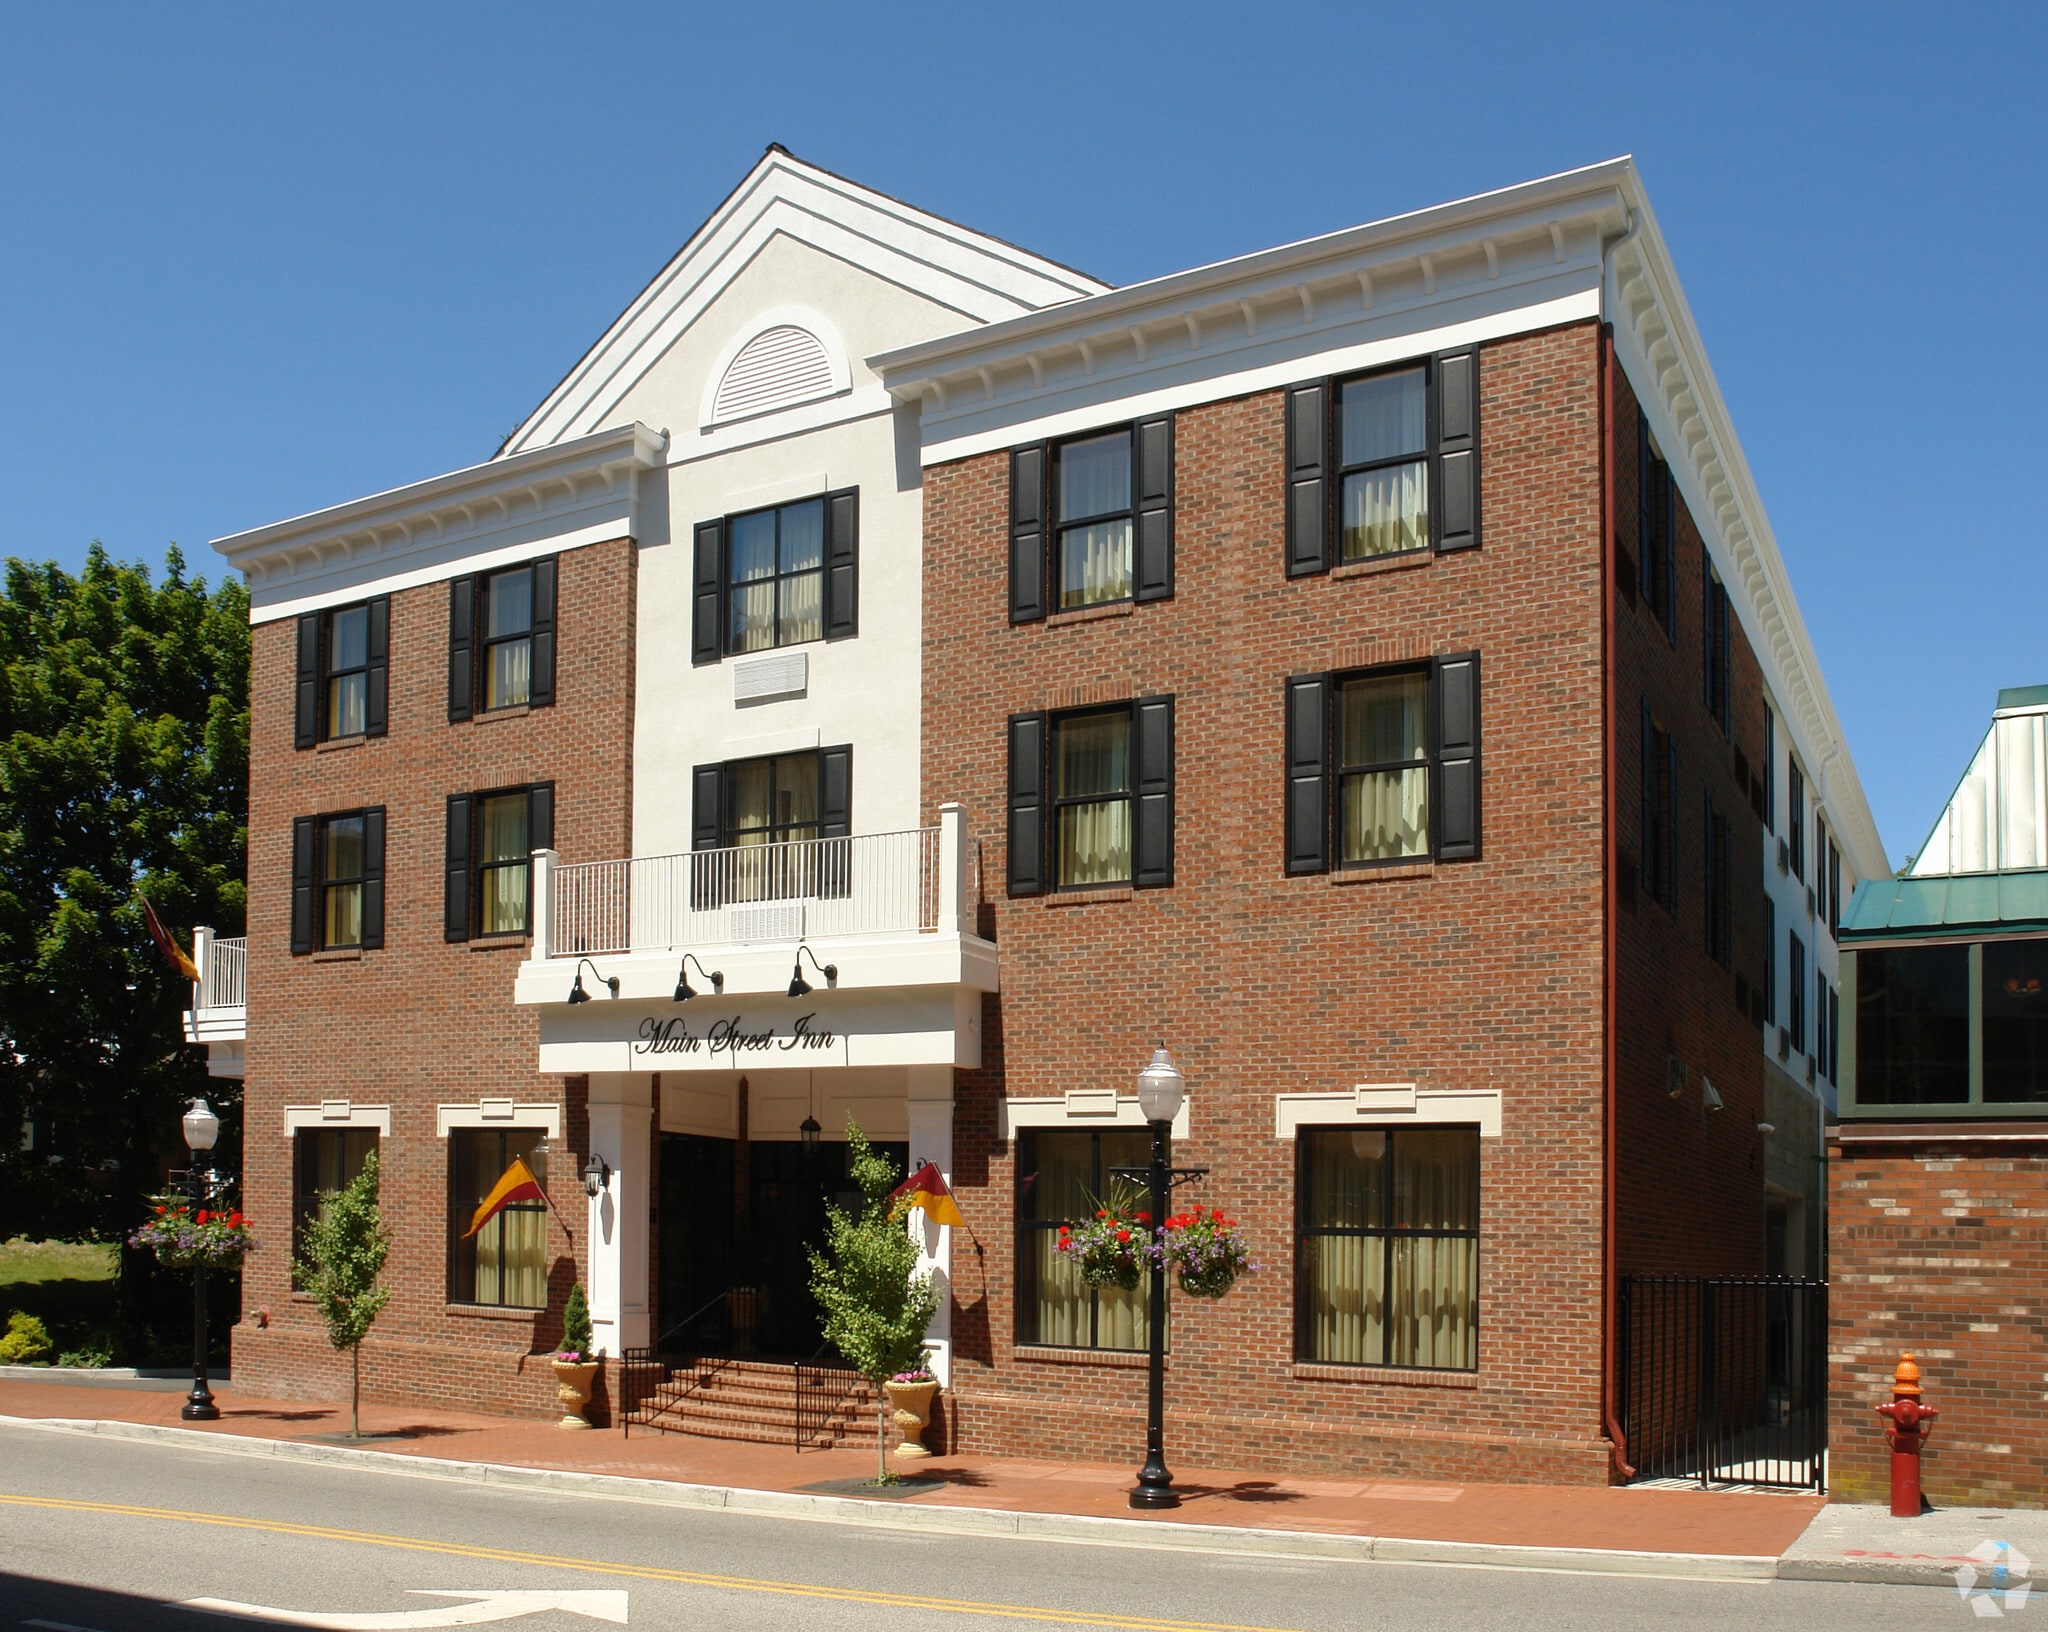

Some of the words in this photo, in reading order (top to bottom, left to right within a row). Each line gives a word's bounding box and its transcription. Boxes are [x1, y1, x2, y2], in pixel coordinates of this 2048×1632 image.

[636, 1017, 701, 1054] Main
[708, 1016, 774, 1060] Street
[778, 1013, 835, 1051] Inn
